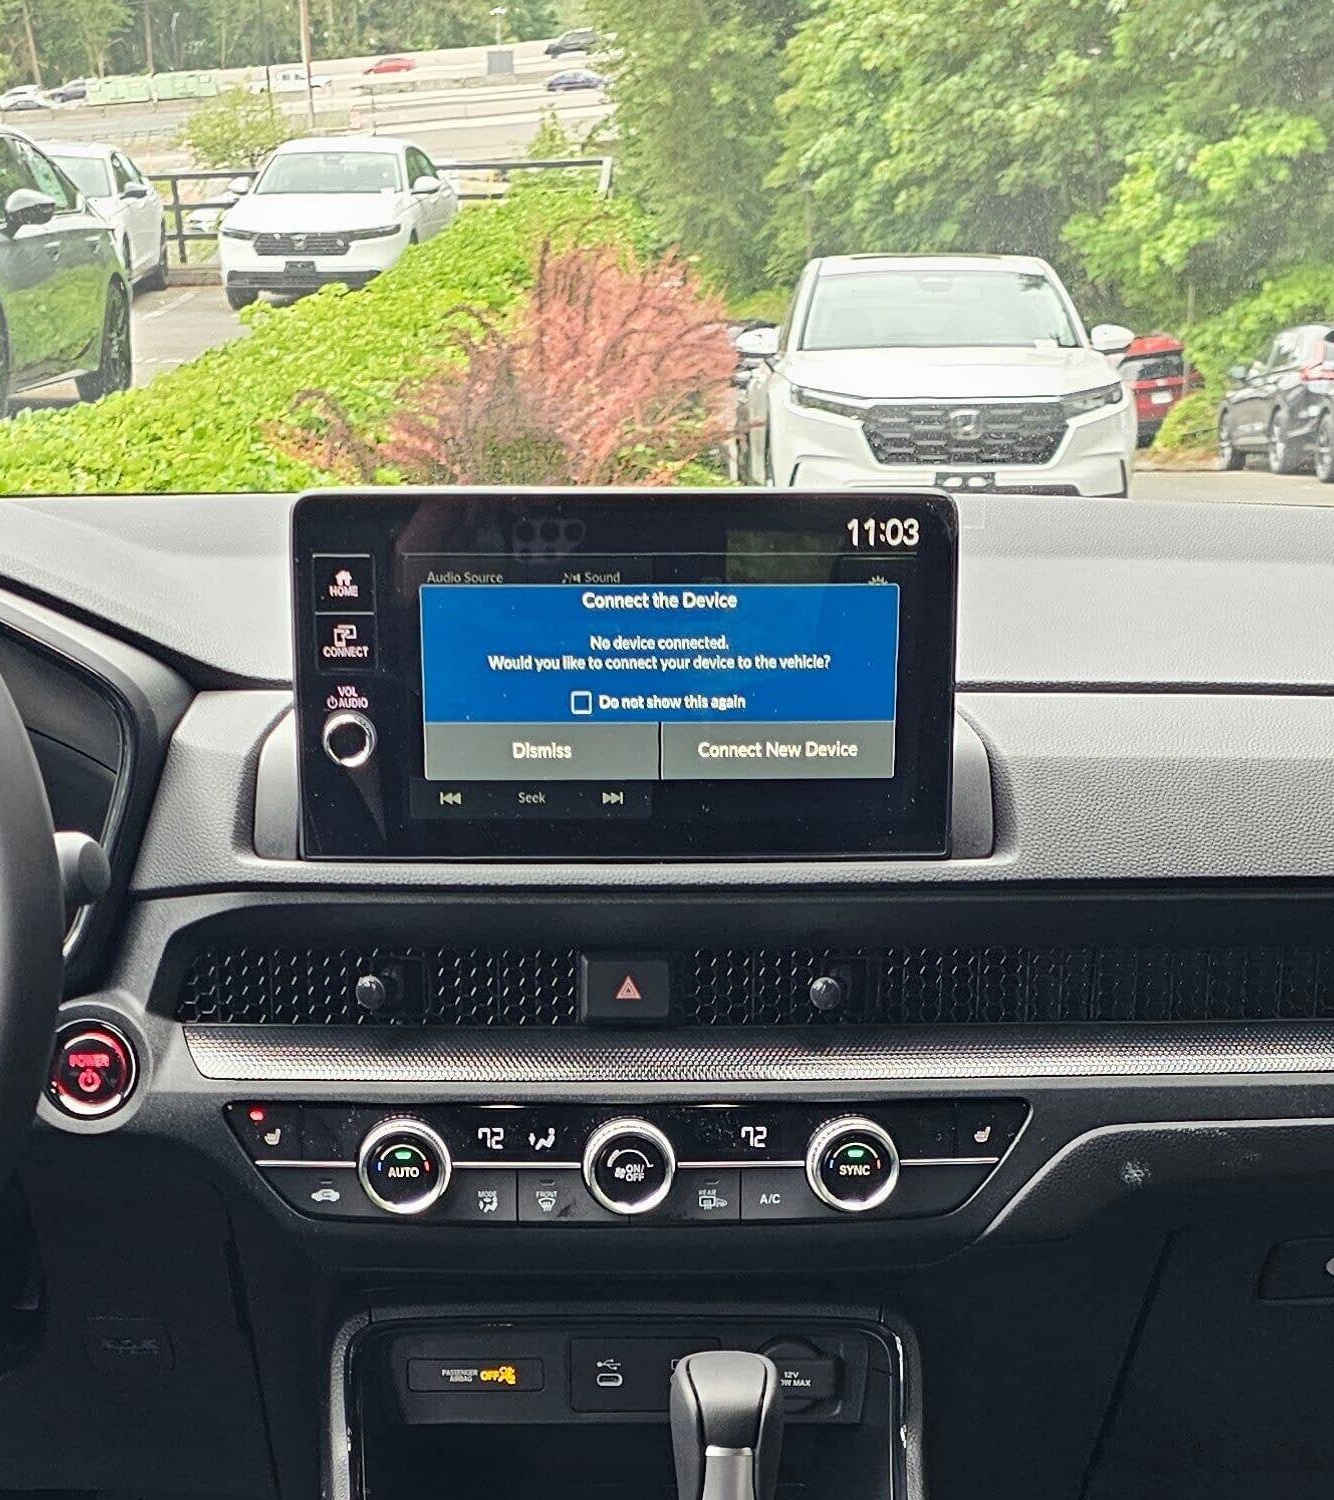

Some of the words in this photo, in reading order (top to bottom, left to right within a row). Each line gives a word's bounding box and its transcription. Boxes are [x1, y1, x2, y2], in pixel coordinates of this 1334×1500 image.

[846, 517, 920, 547] 11:03
[426, 571, 461, 584] Audio
[464, 571, 503, 583] Source
[584, 571, 620, 583] Sound
[329, 585, 358, 597] HOME
[582, 591, 649, 609] Connect
[652, 592, 679, 609] the
[682, 591, 738, 609] Device
[590, 636, 610, 650] No
[613, 635, 655, 650] device
[657, 635, 729, 650] connected.
[322, 646, 369, 658] CONNECT
[487, 655, 532, 671] Would
[535, 657, 560, 673] you
[563, 655, 586, 671] like
[588, 656, 603, 671] to
[605, 656, 657, 671] connect
[660, 657, 690, 672] your
[693, 655, 735, 670] device
[737, 656, 752, 670] to
[755, 654, 777, 670] the
[779, 654, 831, 670] vehicle?
[337, 685, 358, 698] VOL
[338, 697, 369, 709] AUDIO
[599, 695, 620, 710] Do
[622, 696, 644, 710] not
[646, 695, 682, 709] show
[684, 694, 708, 709] this
[710, 695, 746, 711] again
[512, 742, 573, 760] Dismiss
[697, 741, 762, 759] Connect
[766, 741, 802, 758] New
[805, 740, 859, 758] Device
[518, 791, 546, 804] Seek
[477, 1127, 505, 1150] 72
[740, 1126, 768, 1148] 72
[387, 1166, 420, 1179] AUTO
[625, 1163, 645, 1174] ON/
[838, 1164, 871, 1177] SYNC
[625, 1172, 645, 1182] OFF
[477, 1190, 498, 1199] MODE
[535, 1190, 558, 1199] FRONT
[759, 1193, 781, 1205] A/C
[480, 1370, 500, 1381] OFF
[784, 1371, 800, 1379] 12V
[792, 1379, 812, 1387] MAX
